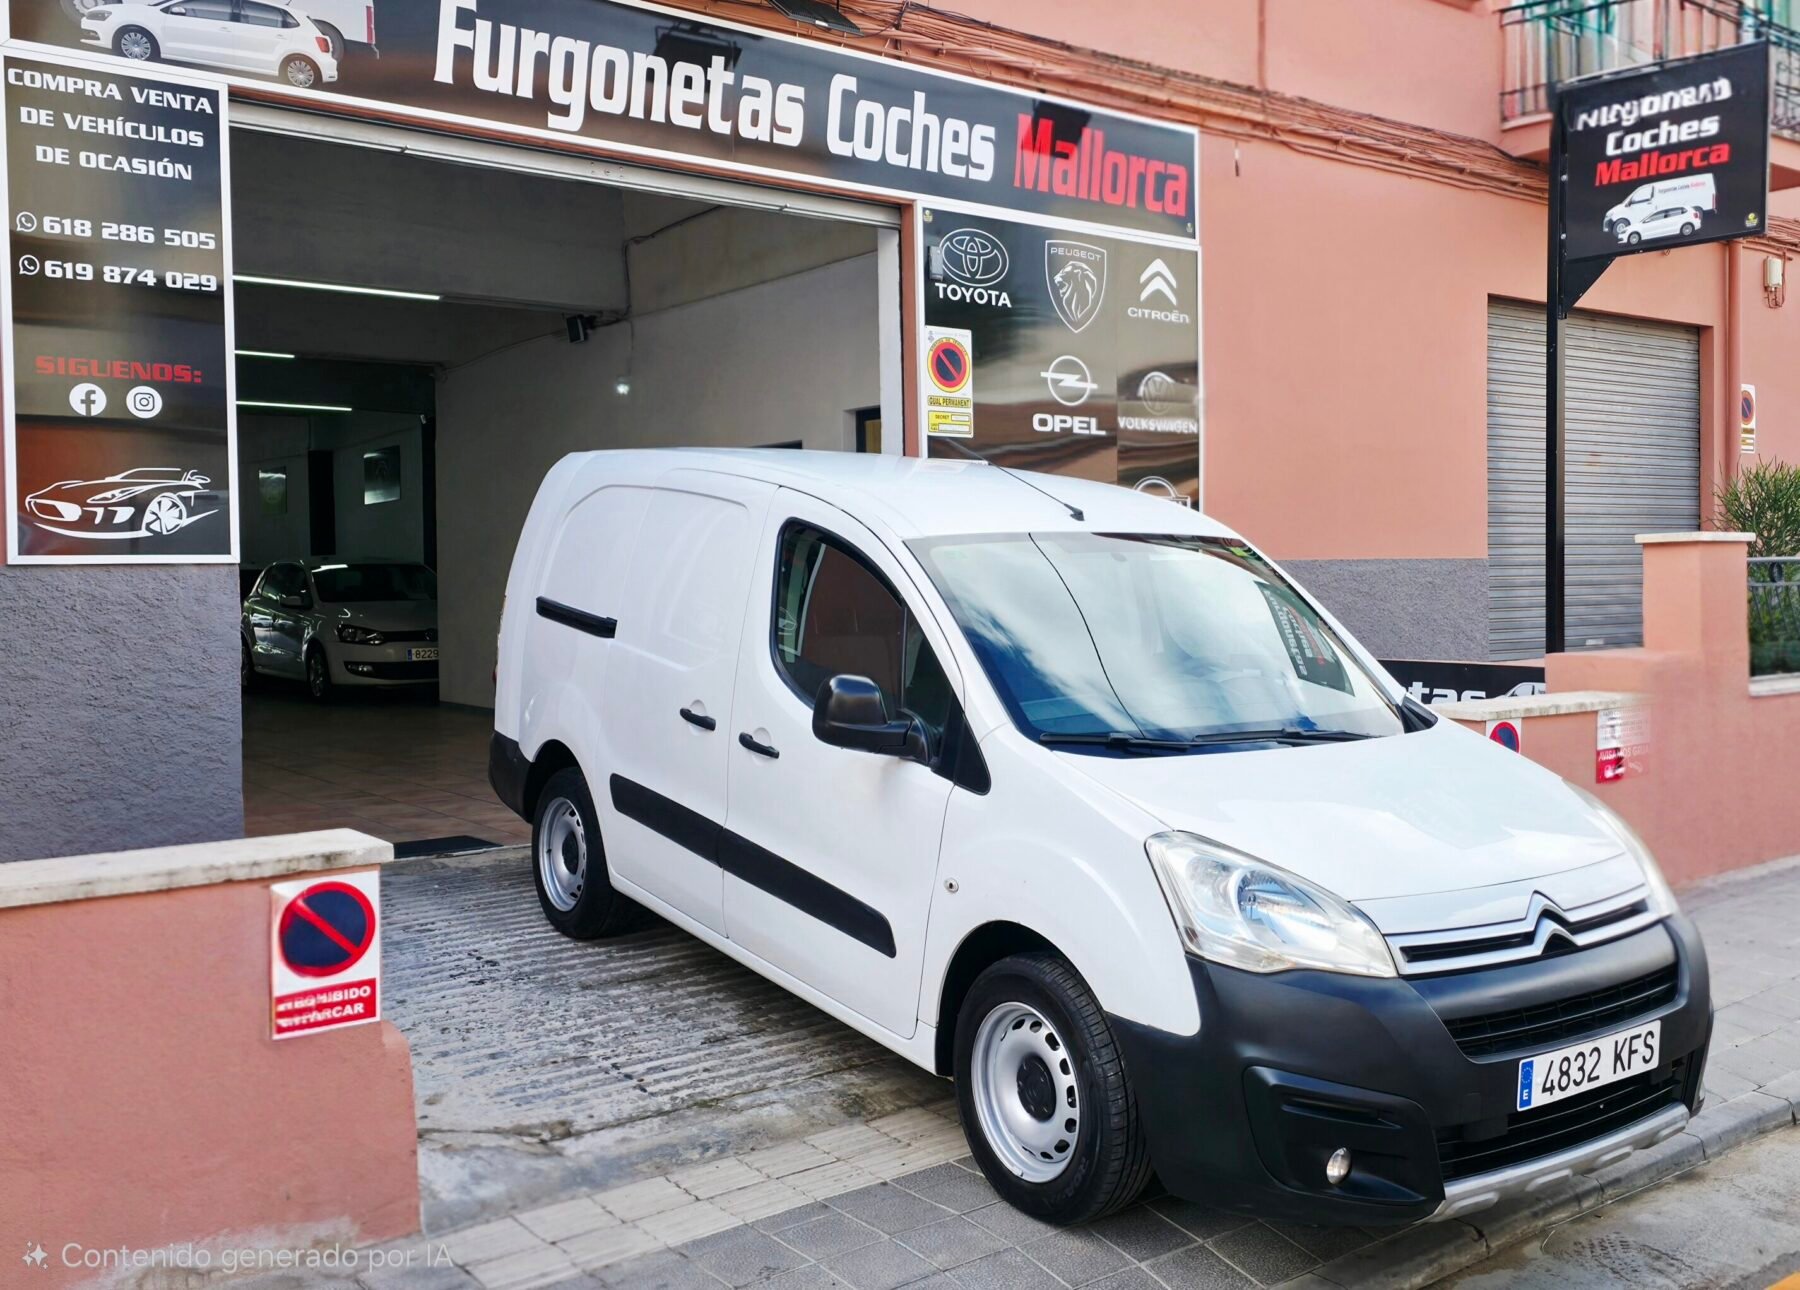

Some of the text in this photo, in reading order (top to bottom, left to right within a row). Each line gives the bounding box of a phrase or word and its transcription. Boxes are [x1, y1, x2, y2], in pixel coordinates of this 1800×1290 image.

[7, 67, 213, 114] COMPRA VENTA
[434, 0, 1189, 217] Furgonetas Coches Mallorca
[20, 106, 204, 148] DE VEHÍCULOS
[1605, 116, 1721, 156] Coches
[35, 145, 192, 181] DE OCASIÓN
[1594, 143, 1730, 186] Mallorca
[43, 216, 216, 250] 618 286 505
[1050, 247, 1102, 261] PEUGEOT
[44, 260, 217, 291] 619 874 029
[935, 282, 1012, 308] TOYOTA
[1127, 306, 1189, 324] CITROËN
[35, 355, 202, 383] SIGUENOS:
[1032, 413, 1106, 435] OPEL
[1117, 416, 1198, 434] VOLKSWAGEN
[415, 649, 439, 659] 8229
[1522, 1030, 1655, 1100] E 4832 KFS
